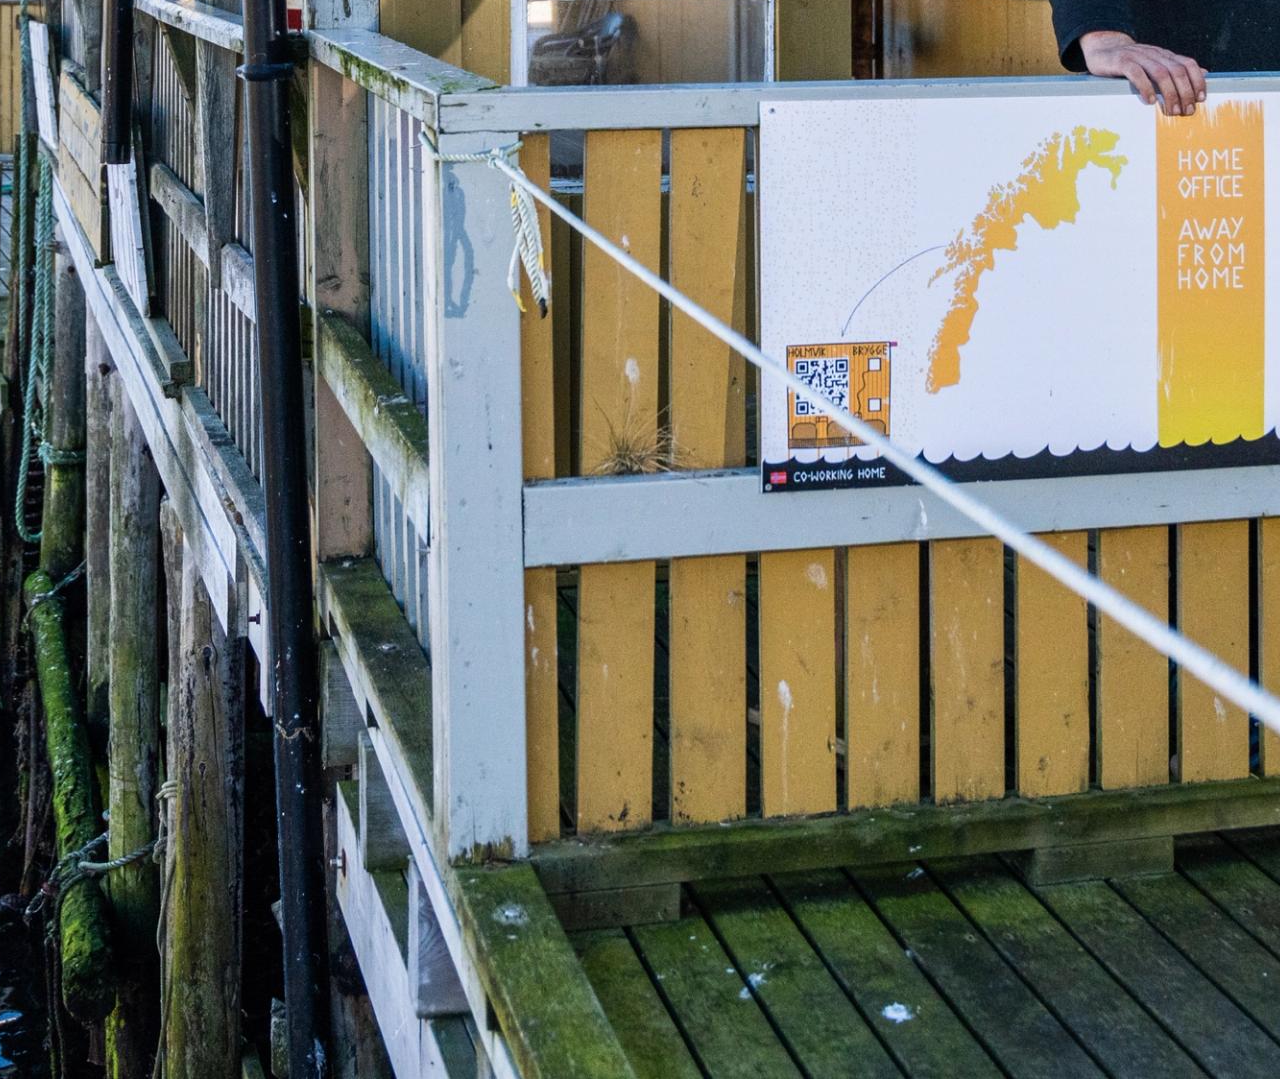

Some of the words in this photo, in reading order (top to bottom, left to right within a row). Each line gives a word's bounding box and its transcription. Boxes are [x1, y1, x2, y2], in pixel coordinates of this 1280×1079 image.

[1178, 148, 1245, 171] HOME
[1177, 175, 1245, 199] OFFICE
[1178, 216, 1245, 241] AWAY
[1177, 242, 1245, 266] FROM
[1177, 266, 1245, 290] HOME
[788, 347, 827, 358] HOLMVIK
[852, 344, 888, 356] BRYGGE
[793, 468, 854, 483] CO-WORKING
[857, 467, 886, 480] HOME
